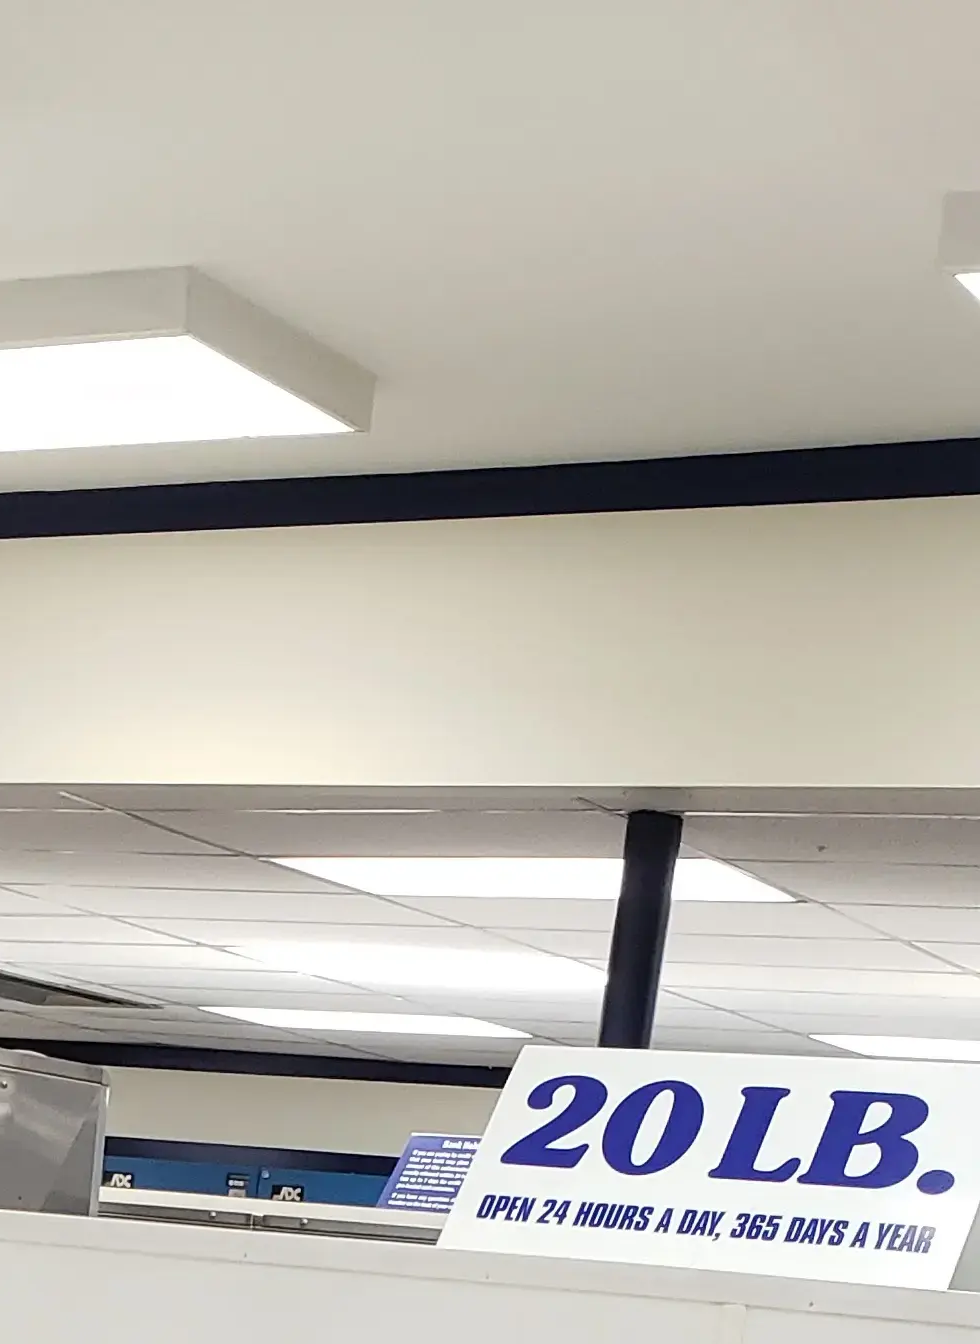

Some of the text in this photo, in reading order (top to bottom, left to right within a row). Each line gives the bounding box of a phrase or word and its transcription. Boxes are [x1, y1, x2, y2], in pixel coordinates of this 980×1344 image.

[500, 1075, 955, 1195] 20 LB.
[476, 1194, 937, 1254] OPEN 24 HOURS A DAY, 365 DAYS A YEAR
